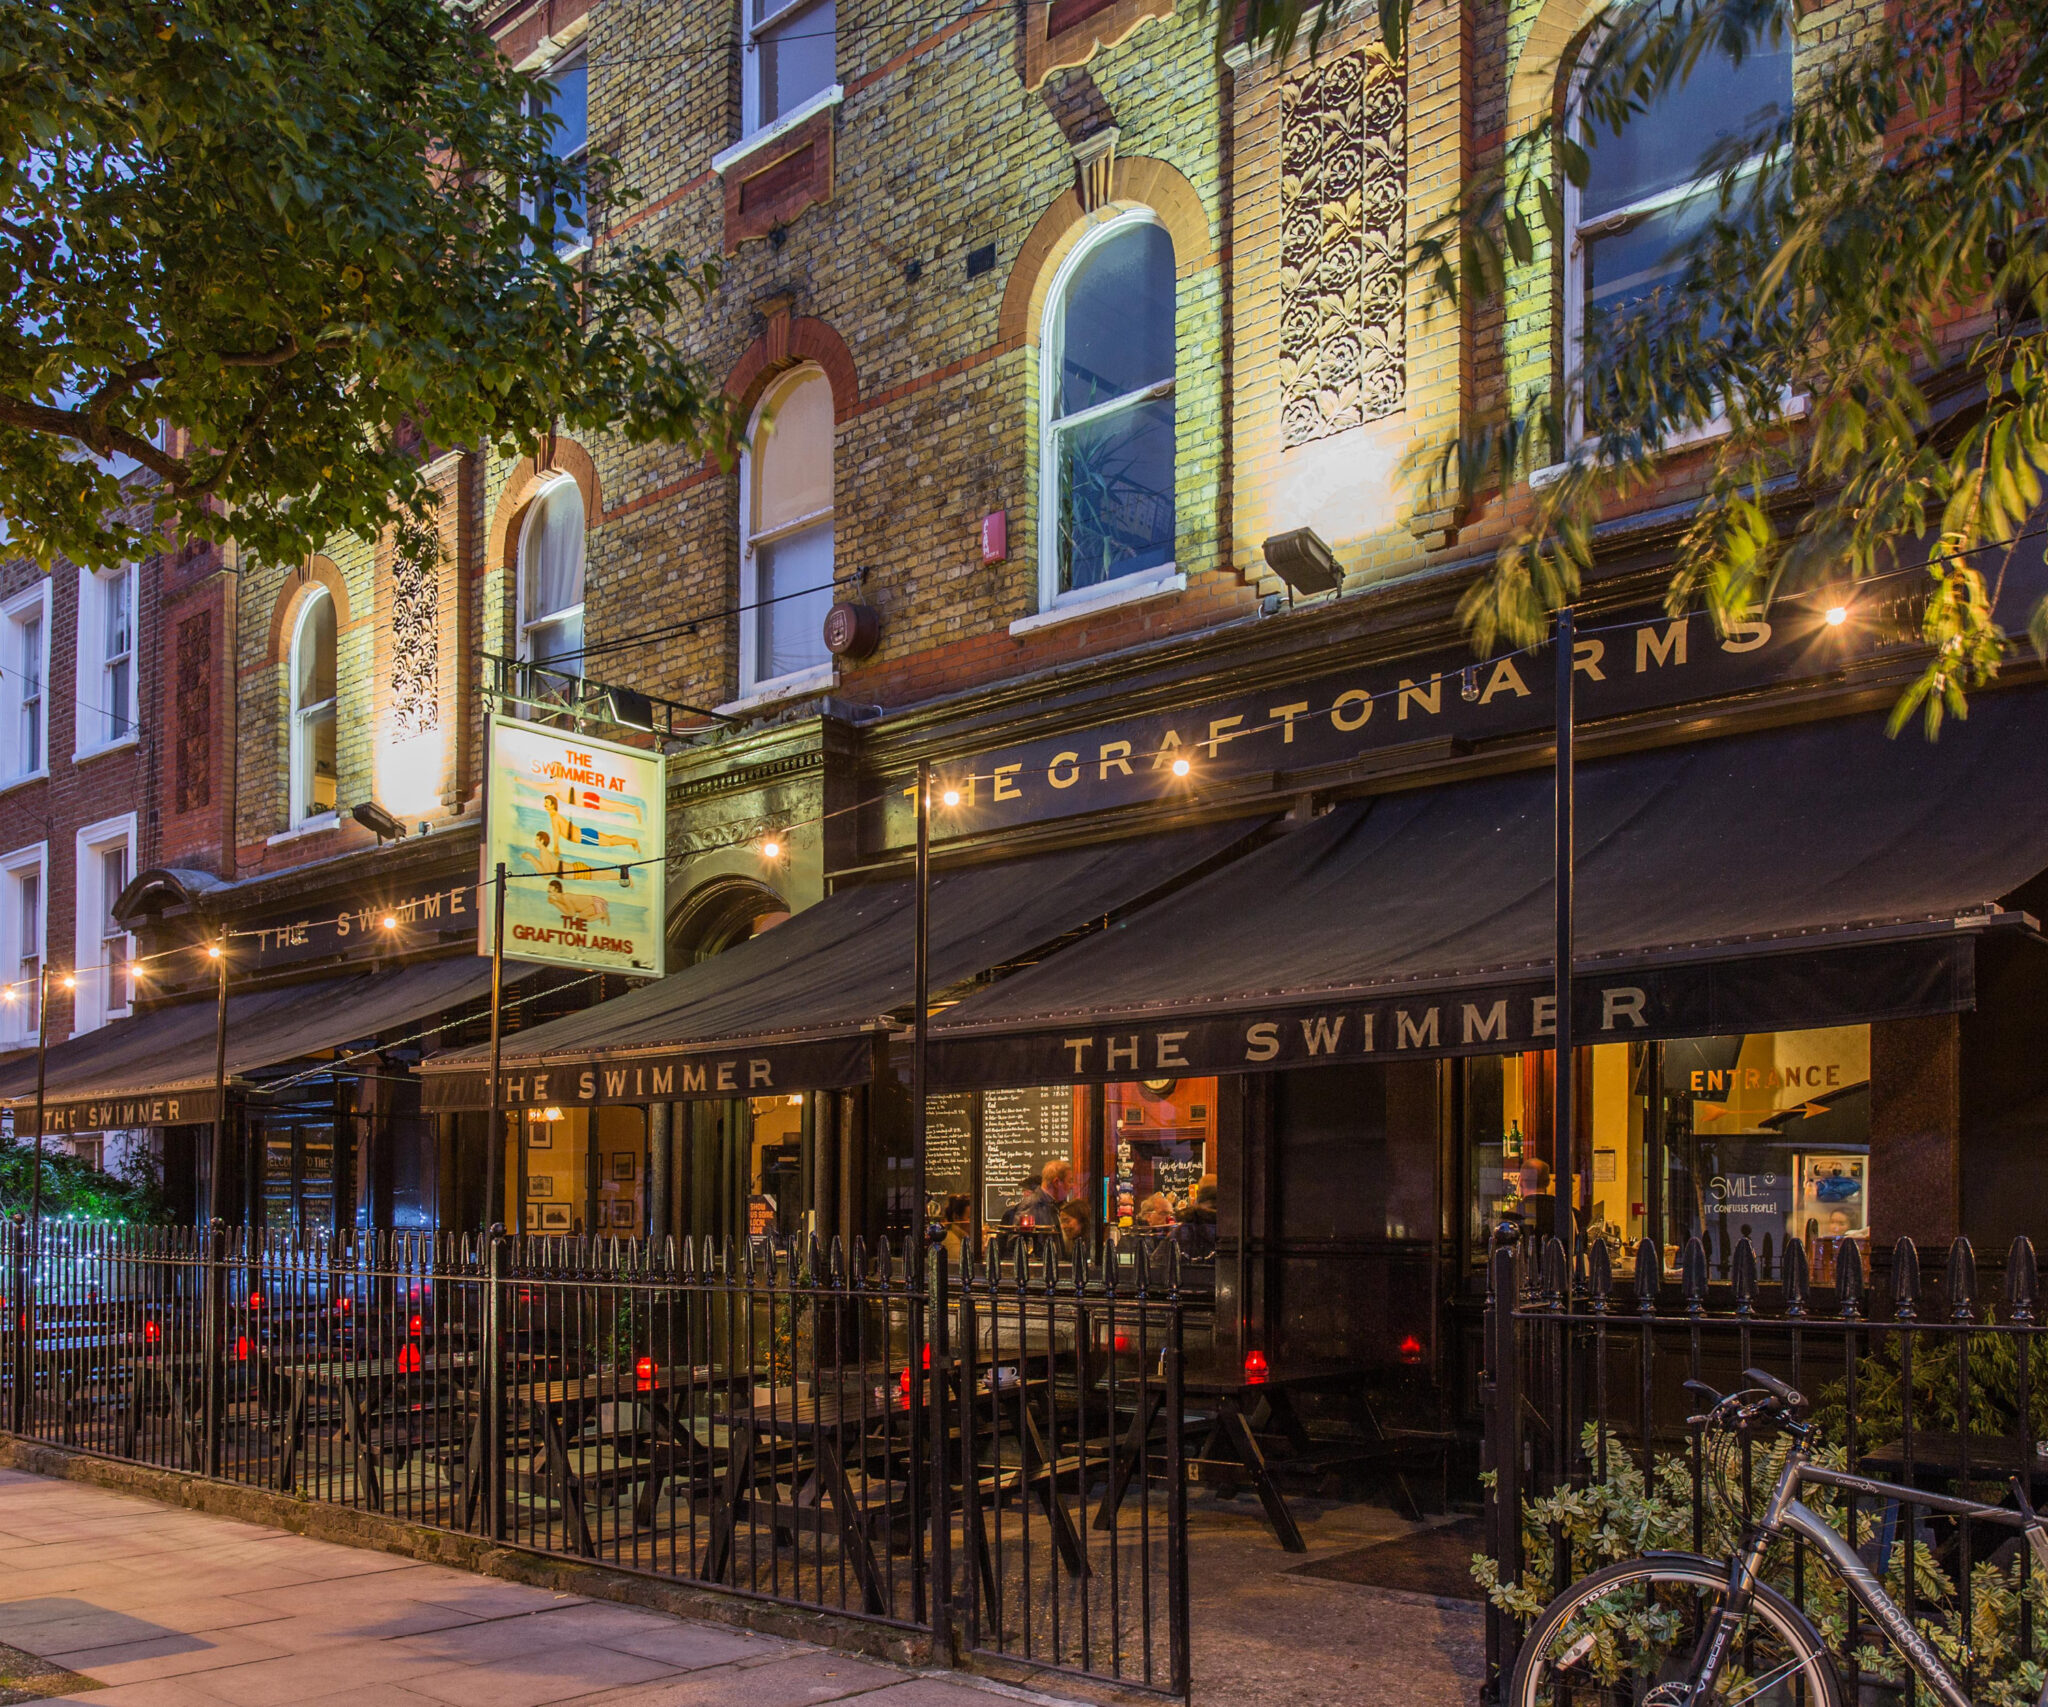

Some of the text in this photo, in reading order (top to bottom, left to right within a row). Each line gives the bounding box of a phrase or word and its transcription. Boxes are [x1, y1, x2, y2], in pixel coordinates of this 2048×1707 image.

[903, 603, 1773, 818] THE GRAFTON ARMS
[565, 750, 592, 768] THE
[531, 759, 626, 792] SWIMMER AT
[257, 885, 480, 952] THE SWMME
[561, 915, 588, 932] THE
[512, 924, 634, 954] GRAFTON ARMS
[1064, 986, 1648, 1074] THE SWIMMER
[485, 1058, 774, 1103] HE SWIMMER
[1690, 1065, 1840, 1091] ENTRANCE
[44, 1110, 76, 1130] THE
[1704, 1202, 1777, 1214] IT CONFUSES PEOPLE!
[1579, 1583, 1620, 1606] TD24
[1867, 1588, 1952, 1689] mongoose
